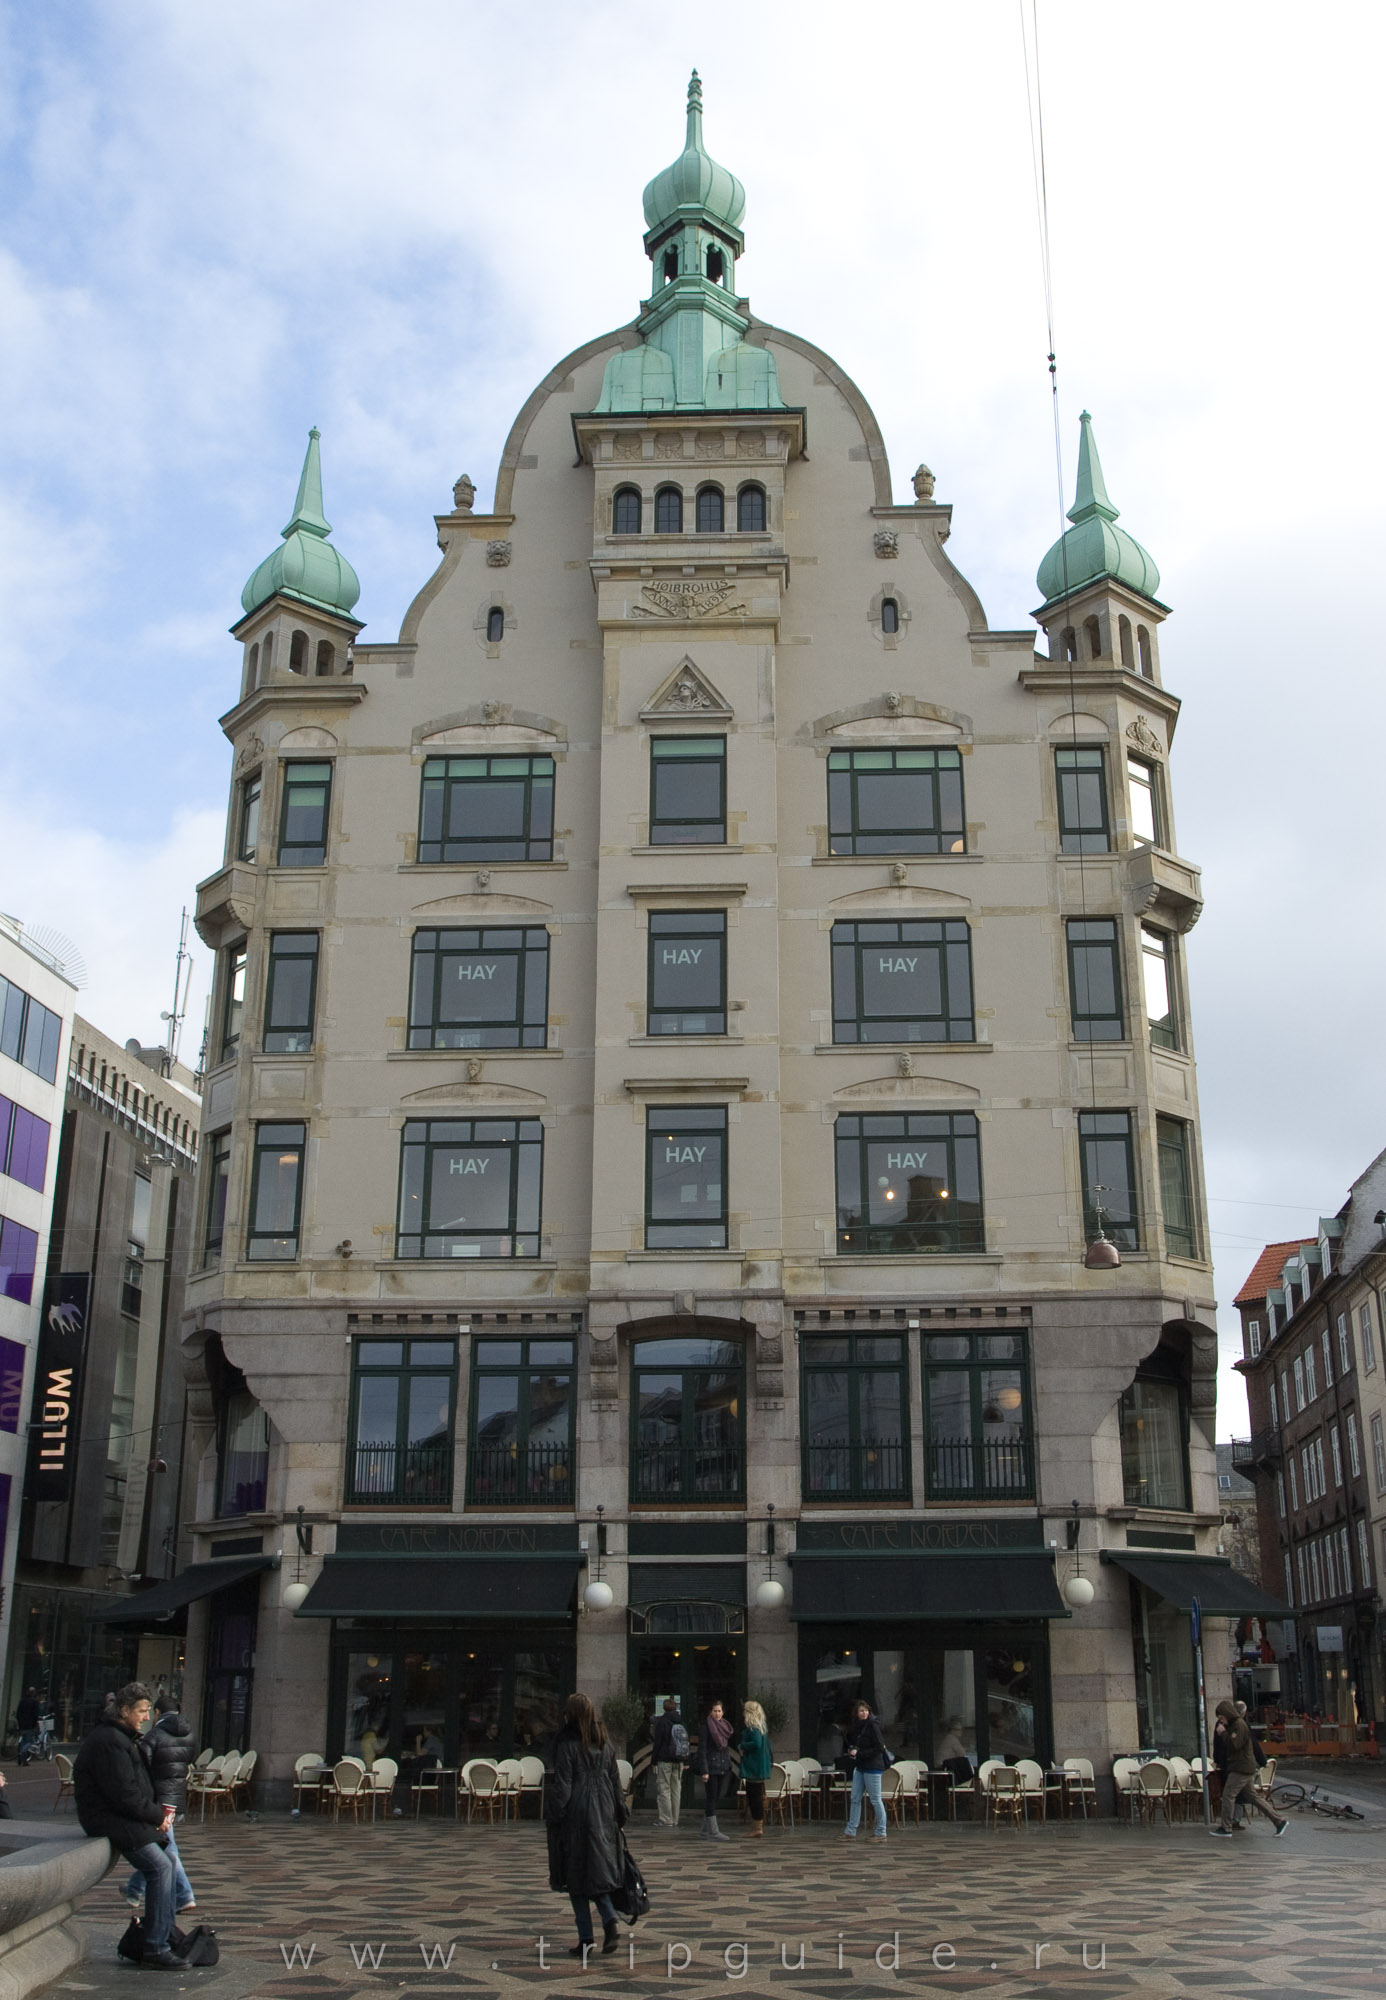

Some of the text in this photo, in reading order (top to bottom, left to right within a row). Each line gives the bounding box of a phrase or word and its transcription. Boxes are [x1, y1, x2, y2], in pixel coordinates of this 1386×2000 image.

[652, 580, 728, 593] HØIBROHUS
[648, 592, 677, 611] ANNO
[702, 591, 727, 610] 1898
[662, 949, 702, 965] HAY
[458, 965, 497, 981] HAY
[879, 958, 918, 973] HAY
[666, 1147, 706, 1163] HAY
[887, 1153, 928, 1169] HAY
[449, 1158, 489, 1175] HAY
[39, 1368, 73, 1470] ILLUM
[448, 1527, 536, 1551] NORDEN
[910, 1524, 998, 1548] NORDEN
